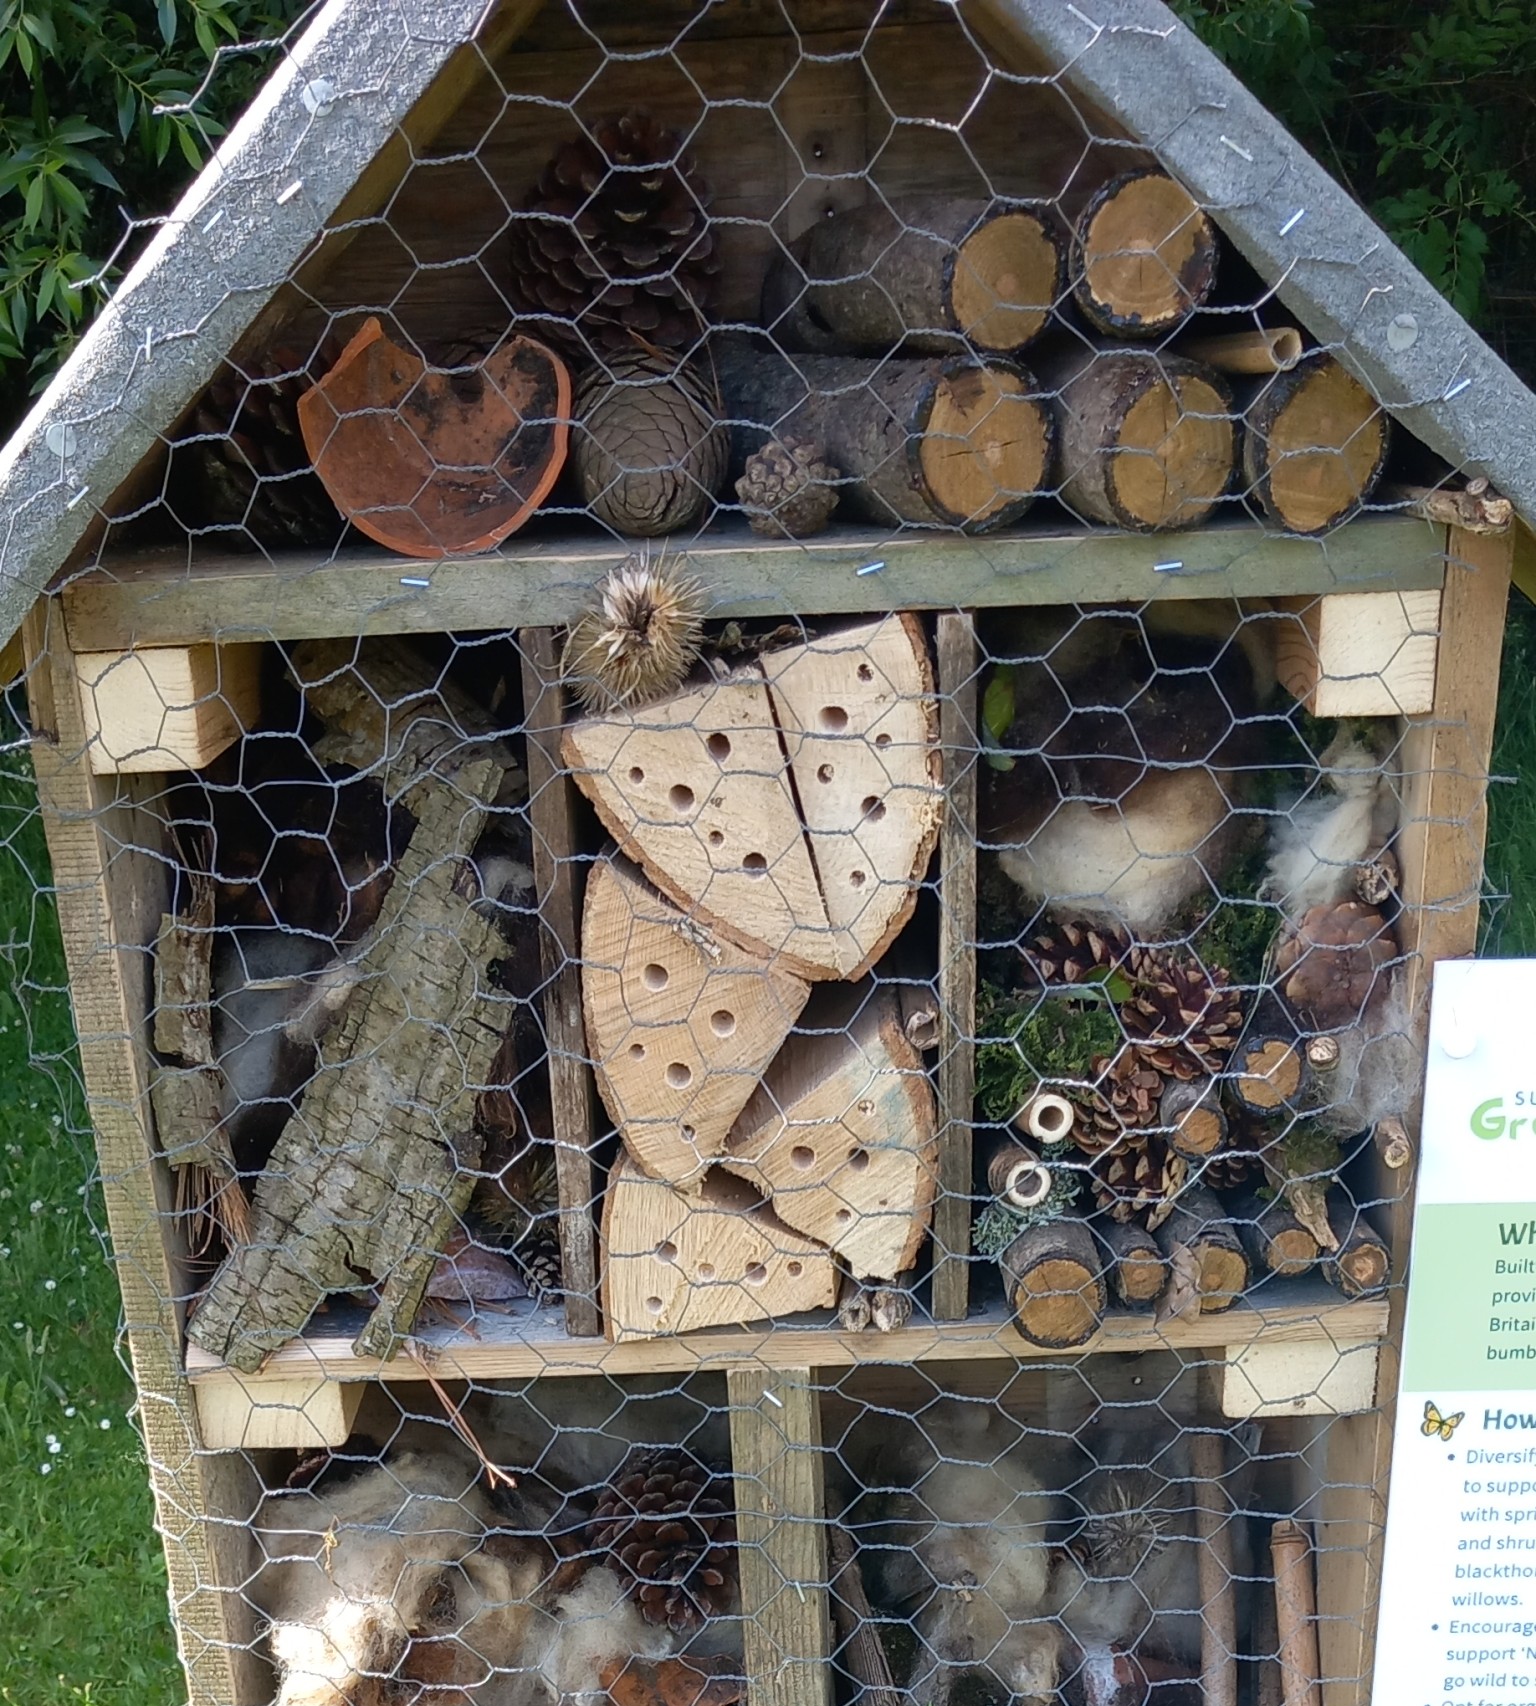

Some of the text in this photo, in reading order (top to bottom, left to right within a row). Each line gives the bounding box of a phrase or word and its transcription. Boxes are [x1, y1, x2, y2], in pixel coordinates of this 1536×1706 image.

[1495, 1258, 1535, 1274] Built
[1466, 1447, 1536, 1467] Diversif
[1463, 1480, 1481, 1493] to
[1460, 1506, 1499, 1522] with
[1457, 1535, 1491, 1550] and
[1451, 1591, 1523, 1606] willows.
[1449, 1619, 1536, 1637] Encourag
[1446, 1648, 1516, 1664] support
[1443, 1676, 1465, 1691] go
[1470, 1673, 1507, 1687] wild
[1511, 1675, 1530, 1687] to
